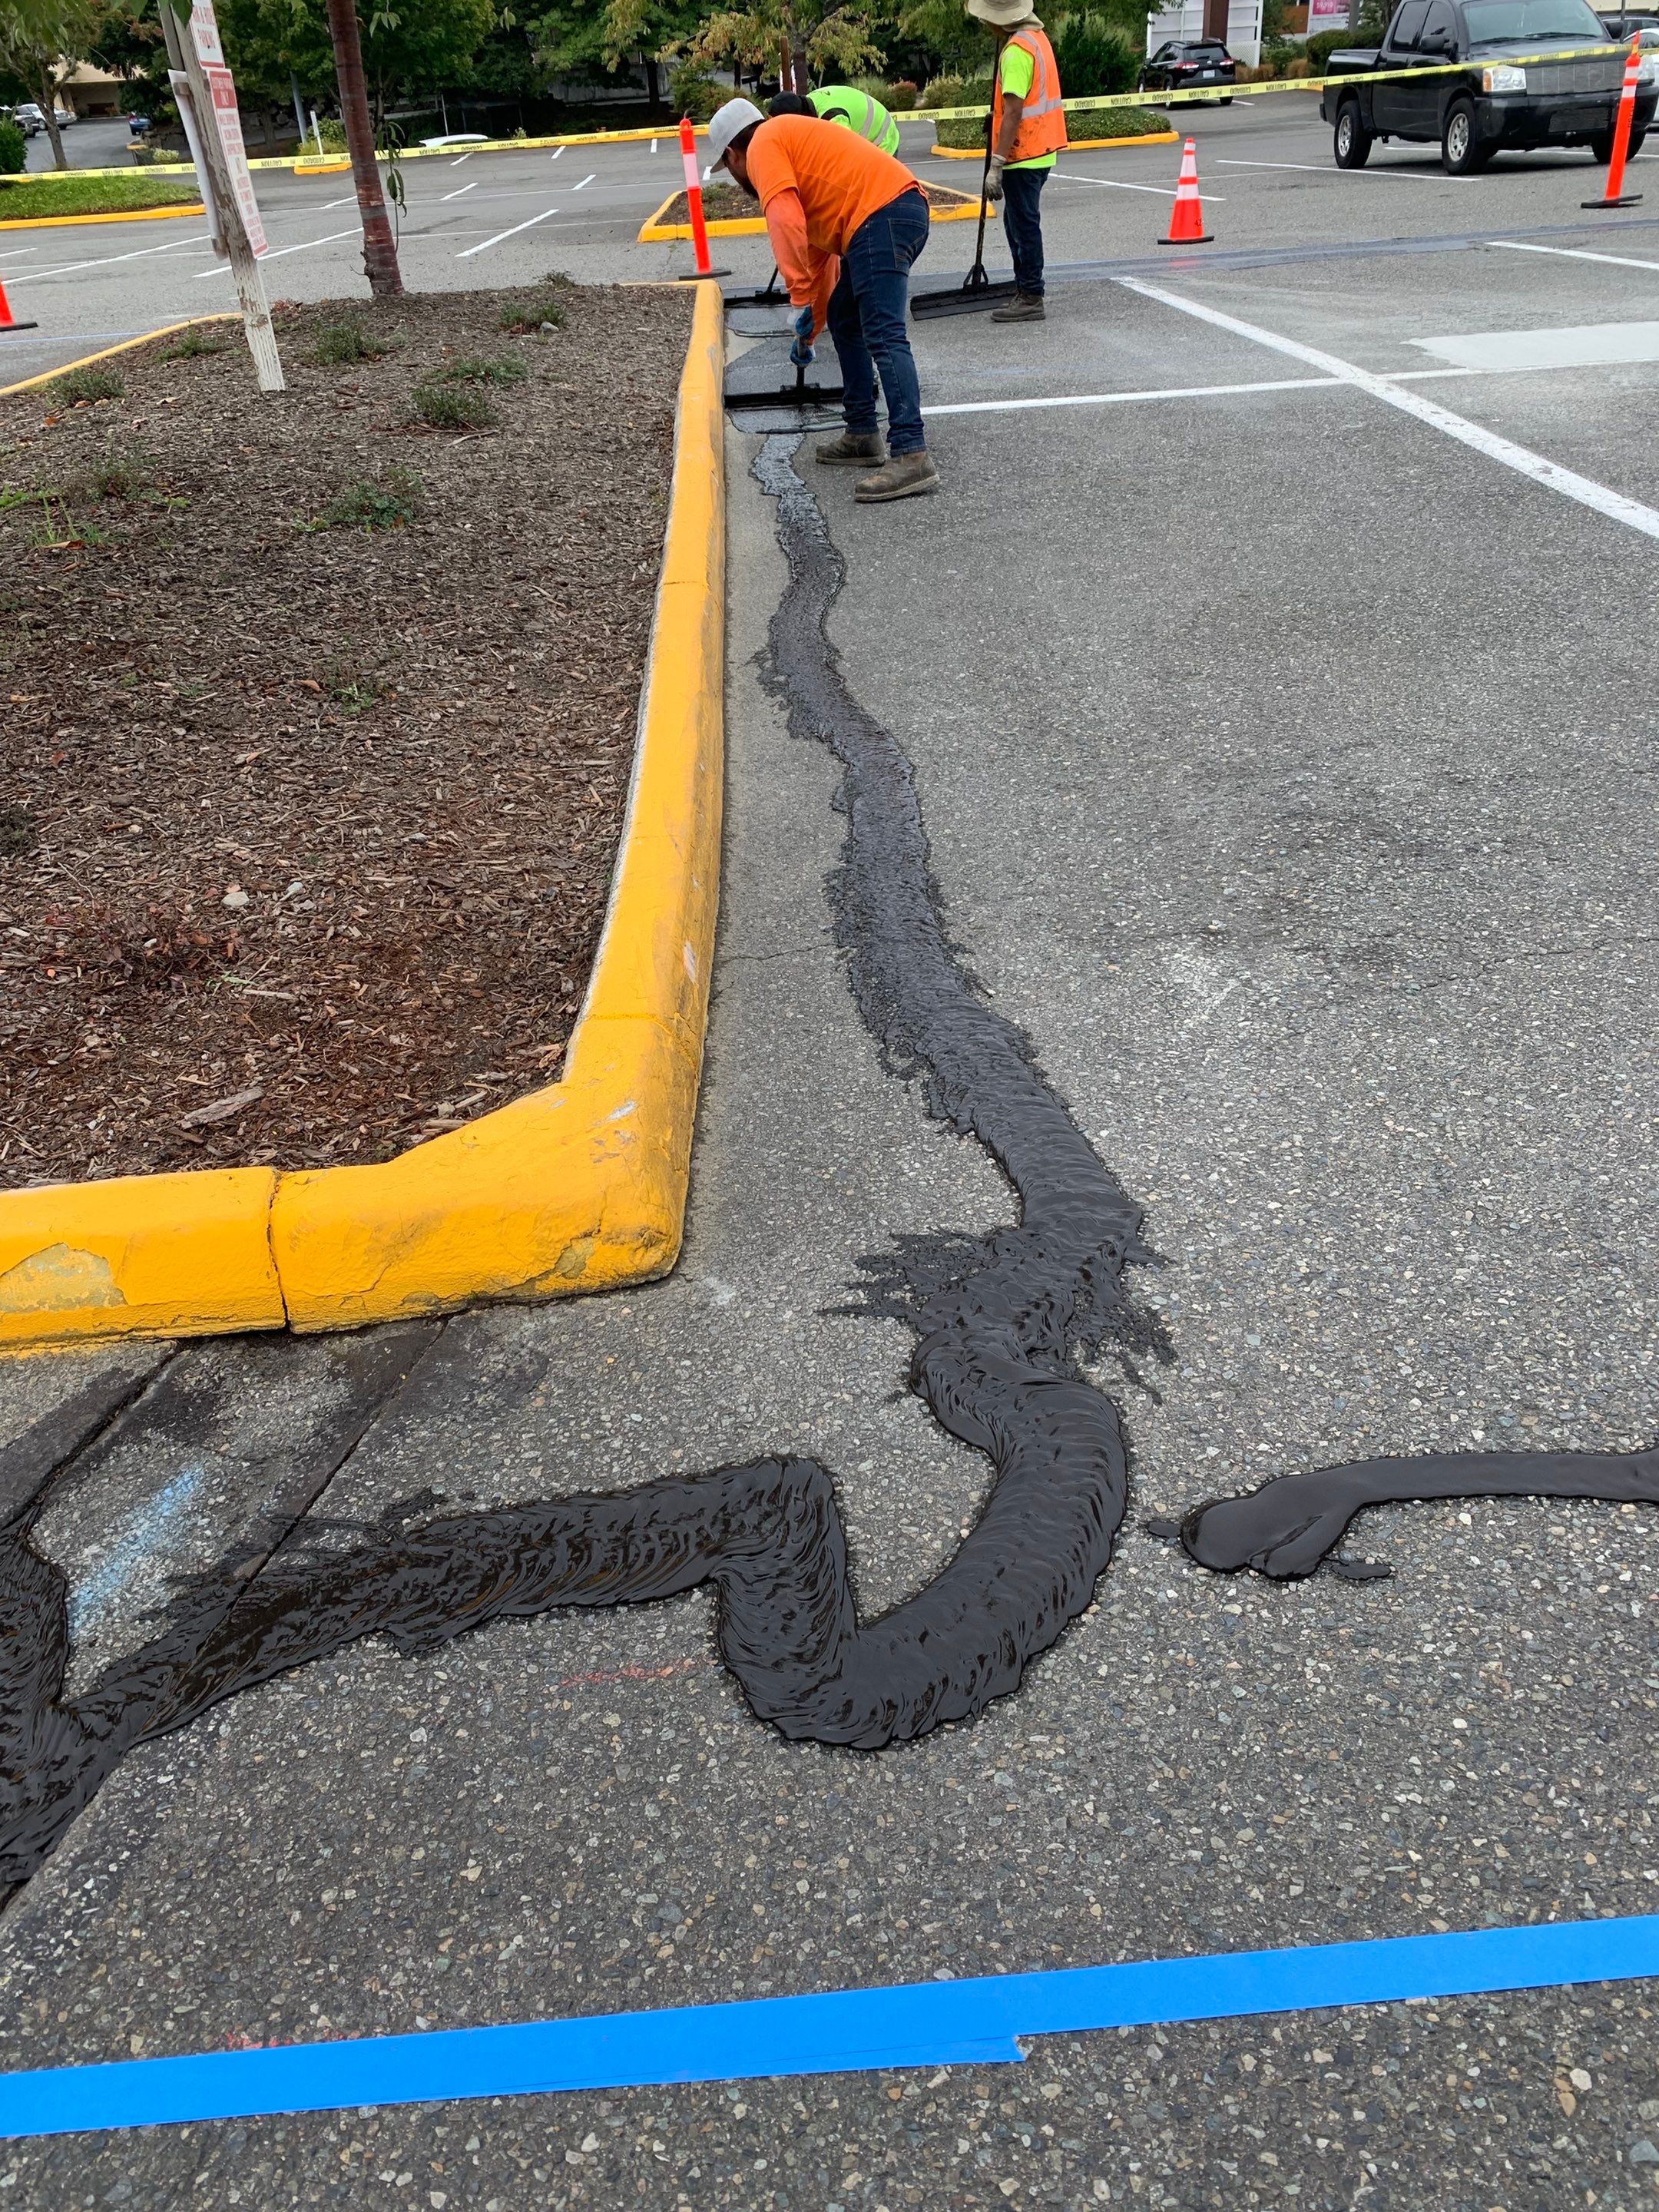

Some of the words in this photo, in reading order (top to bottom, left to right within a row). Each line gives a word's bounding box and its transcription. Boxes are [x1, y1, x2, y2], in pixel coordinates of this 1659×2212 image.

[1230, 86, 1251, 95] CUIDADO
[1266, 83, 1287, 91] CAUTION
[1152, 93, 1174, 102] CUIDADO
[1188, 90, 1210, 99] CAUTION
[1075, 100, 1096, 108] CUIDADO
[1111, 97, 1132, 107] CAUTION
[918, 111, 940, 120] CUIDADO
[954, 109, 975, 118] CAUTION
[303, 156, 326, 164] CUIDADO
[144, 166, 167, 175] CUIDADO
